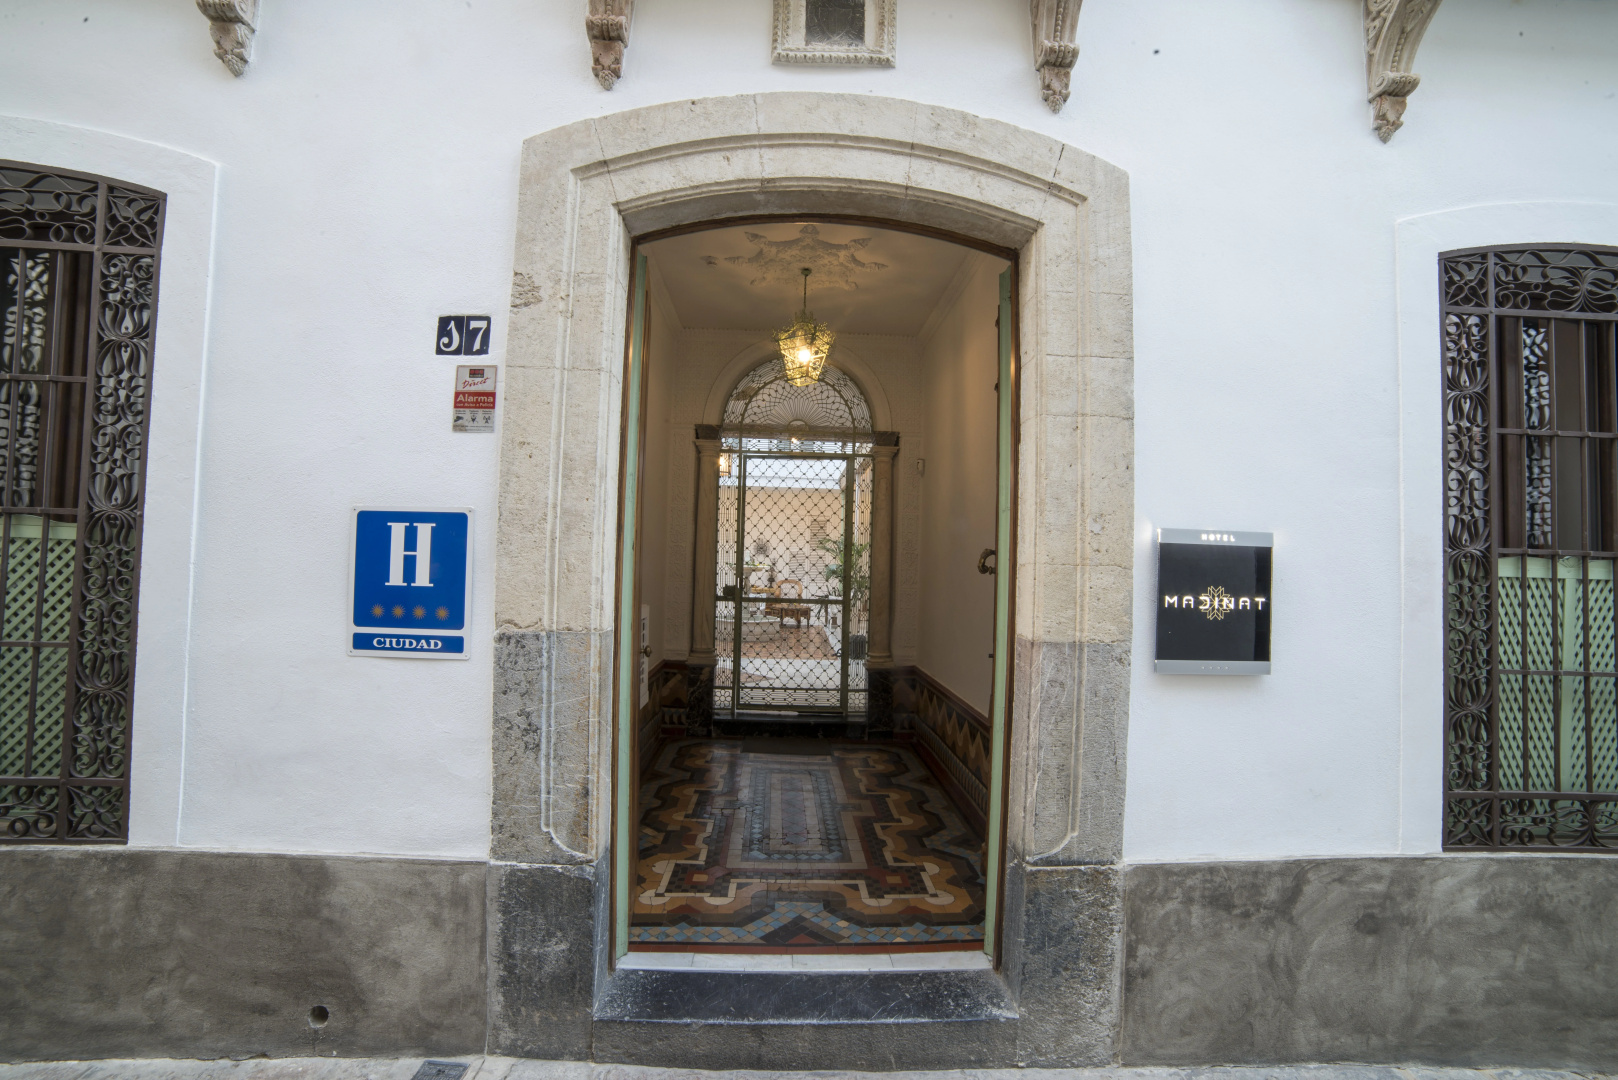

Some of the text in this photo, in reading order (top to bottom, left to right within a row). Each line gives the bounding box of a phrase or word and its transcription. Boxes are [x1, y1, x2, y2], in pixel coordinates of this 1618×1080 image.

[457, 394, 493, 402] Alarma
[1201, 533, 1236, 542] HOTEL
[384, 522, 437, 587] H
[1164, 595, 1266, 611] MADINAT
[372, 637, 443, 650] CIUDAD
